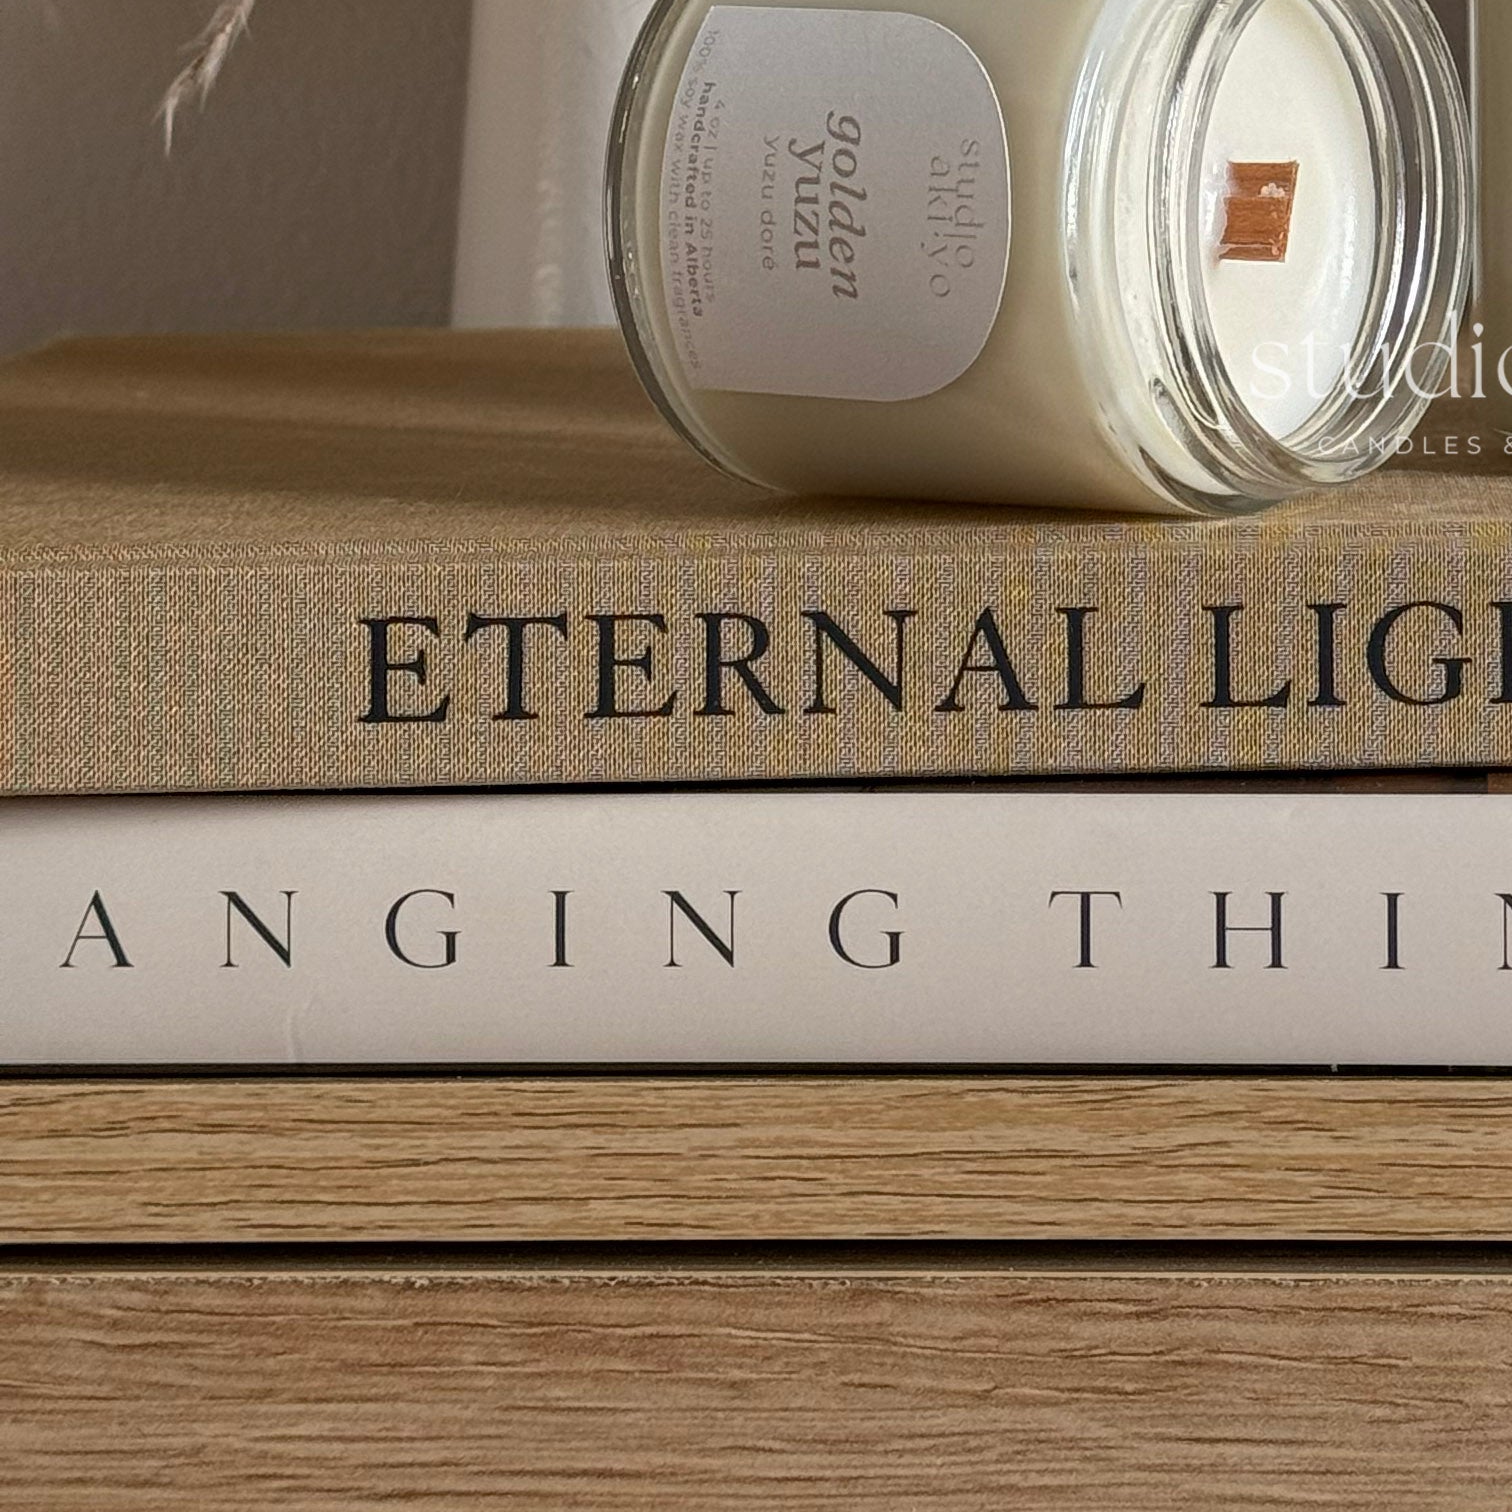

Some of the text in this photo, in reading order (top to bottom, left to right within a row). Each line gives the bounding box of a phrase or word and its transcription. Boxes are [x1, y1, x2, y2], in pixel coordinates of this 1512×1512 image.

[685, 216, 697, 235] in
[762, 135, 780, 199] yuzu
[788, 137, 825, 271] yuzu
[826, 110, 868, 300] golden
[944, 138, 985, 269] studio
[358, 605, 1146, 724] ETERNAL
[59, 887, 903, 971] ANGING
